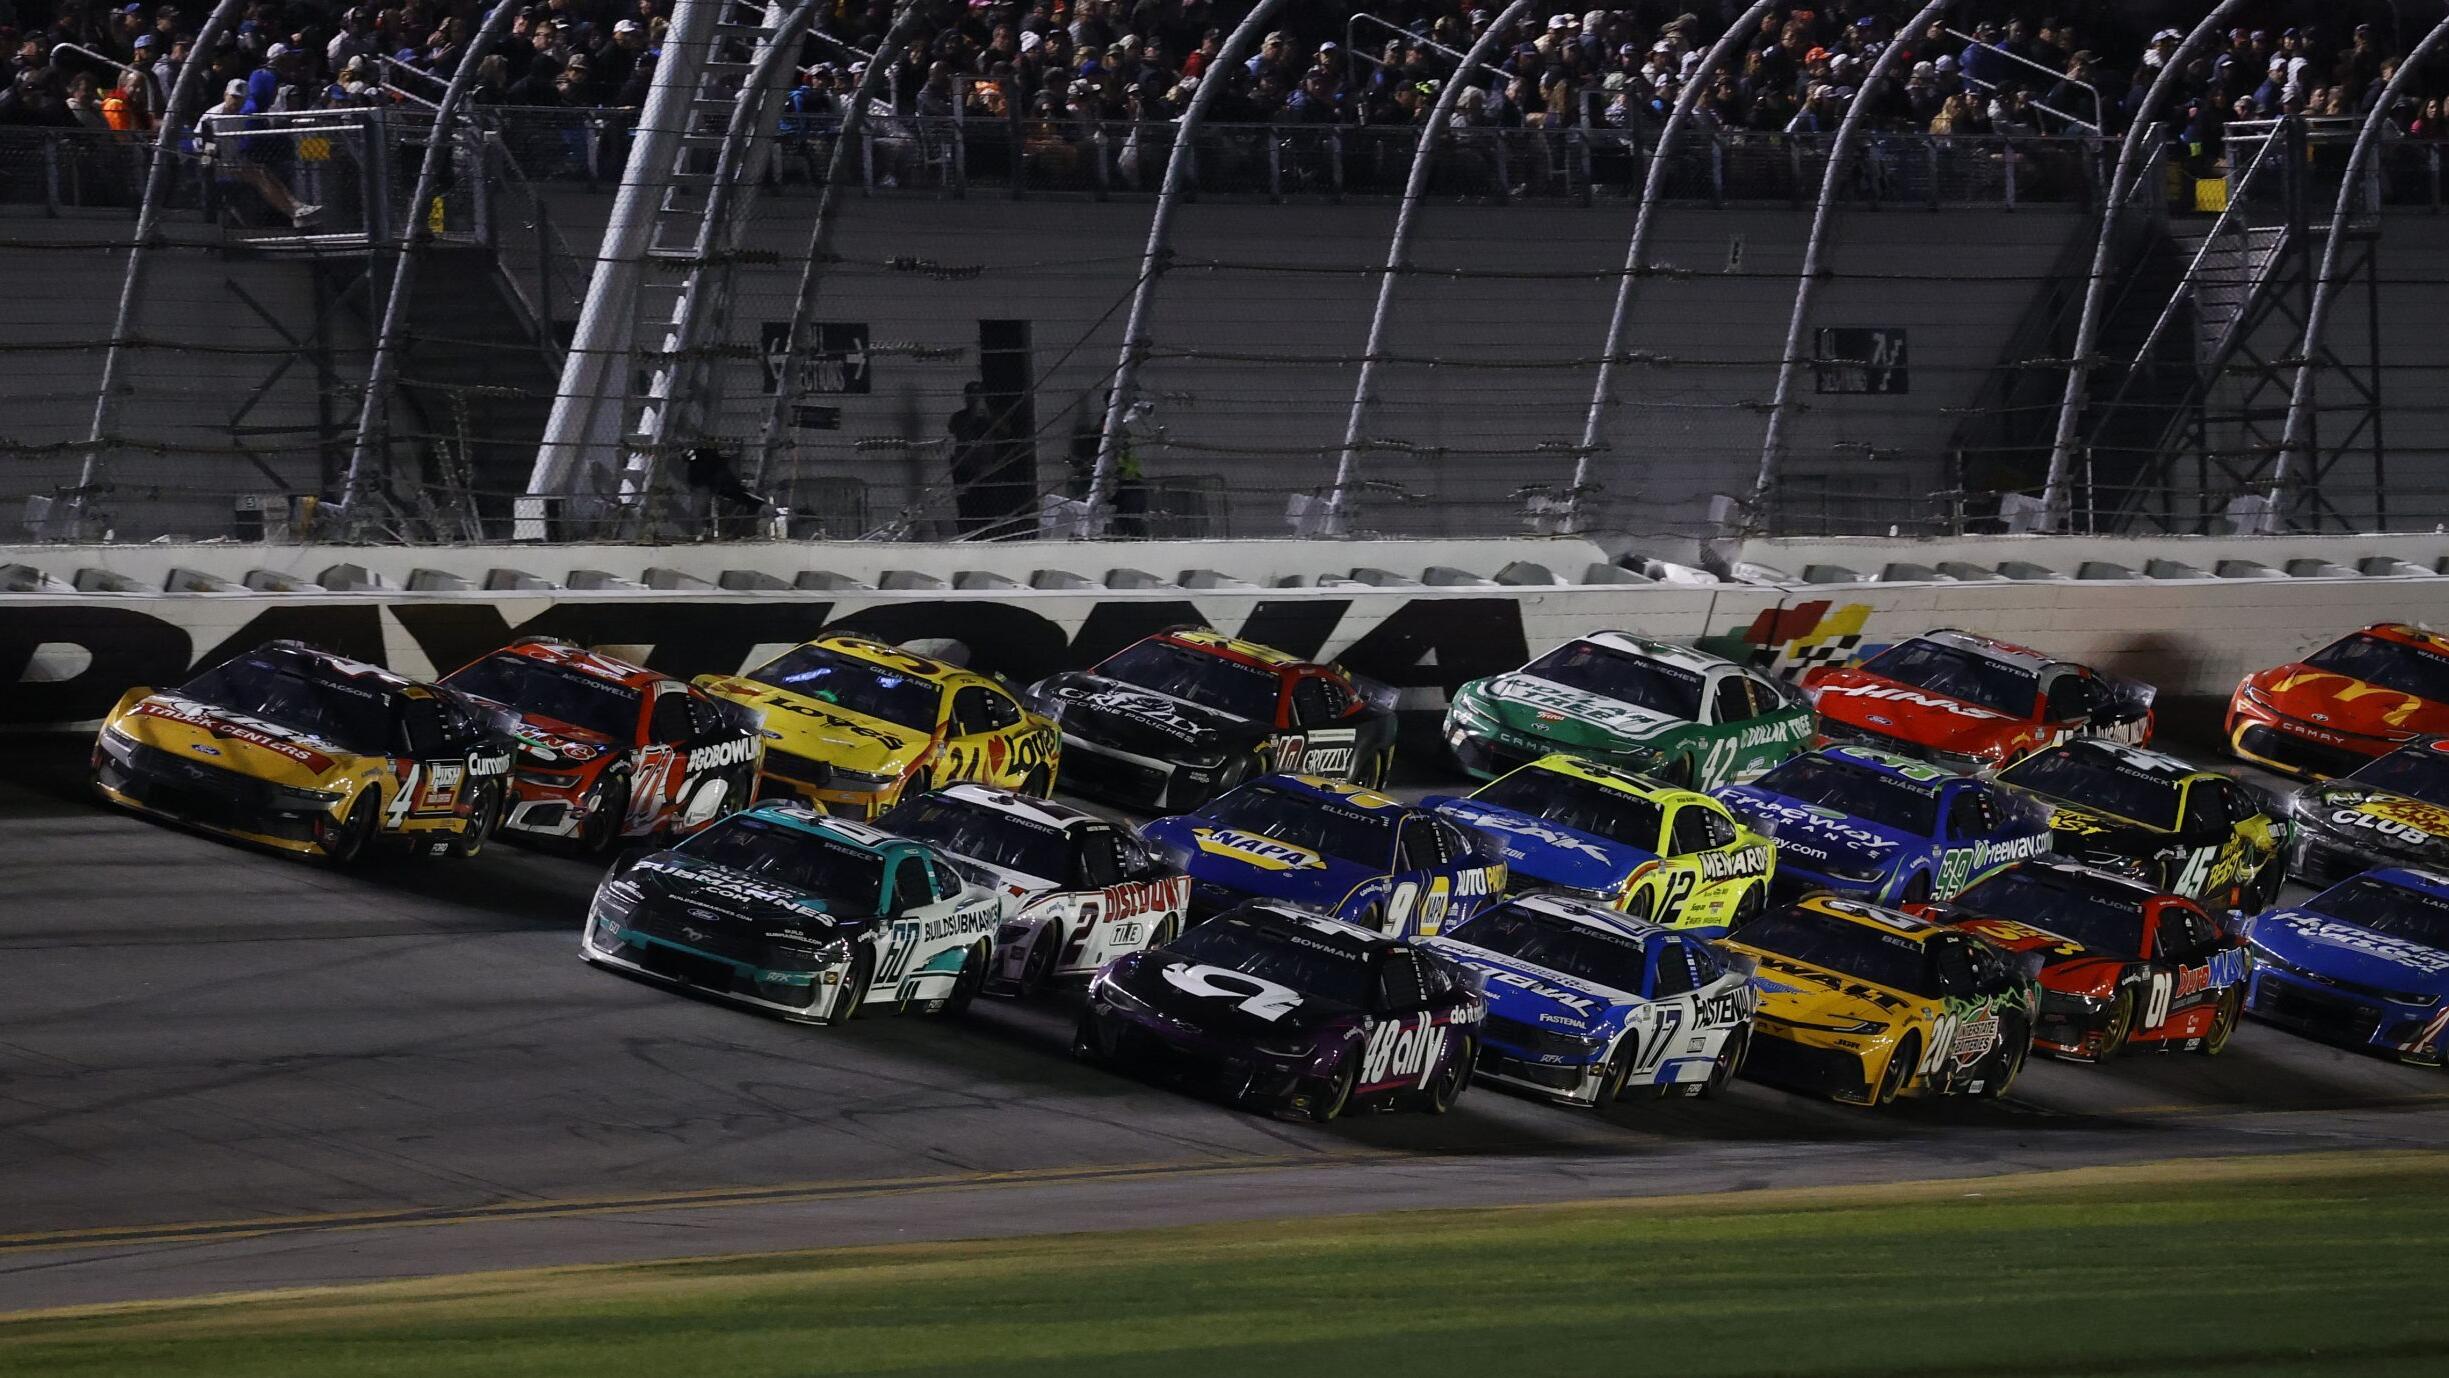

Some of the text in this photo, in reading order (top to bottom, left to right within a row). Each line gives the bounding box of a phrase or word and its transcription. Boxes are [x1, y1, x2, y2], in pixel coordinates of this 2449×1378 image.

[1984, 659, 2031, 679] CUSTER
[2416, 650, 2449, 664] WALL
[219, 723, 312, 760] CENTERS
[1124, 712, 1196, 744] POUCHES
[2281, 722, 2345, 745] CAMRY
[1500, 732, 1556, 756] CAMR
[1303, 747, 1353, 777] GRIZZLY
[1700, 737, 1738, 793] 42
[2115, 766, 2169, 787] REDDICK
[386, 763, 420, 828] 4
[1004, 815, 1056, 836] CINDRIC
[1320, 804, 1378, 825] ELLIOTT
[2331, 809, 2431, 845] CLUB
[1213, 831, 1309, 866] NAPA
[1454, 867, 1486, 897] AUTO
[1381, 881, 1419, 938] 9
[1653, 871, 1696, 924] 12
[2420, 897, 2449, 913] LAR
[608, 922, 620, 934] 60
[1061, 903, 1099, 965] 2
[1290, 935, 1356, 961] BOWMAN
[1880, 935, 1915, 950] BELL
[1539, 1013, 1587, 1029] FASTENAL
[1360, 1010, 1446, 1090] 48 ally
[1917, 1013, 1957, 1074] 20
[1539, 1054, 1563, 1064] RFK
